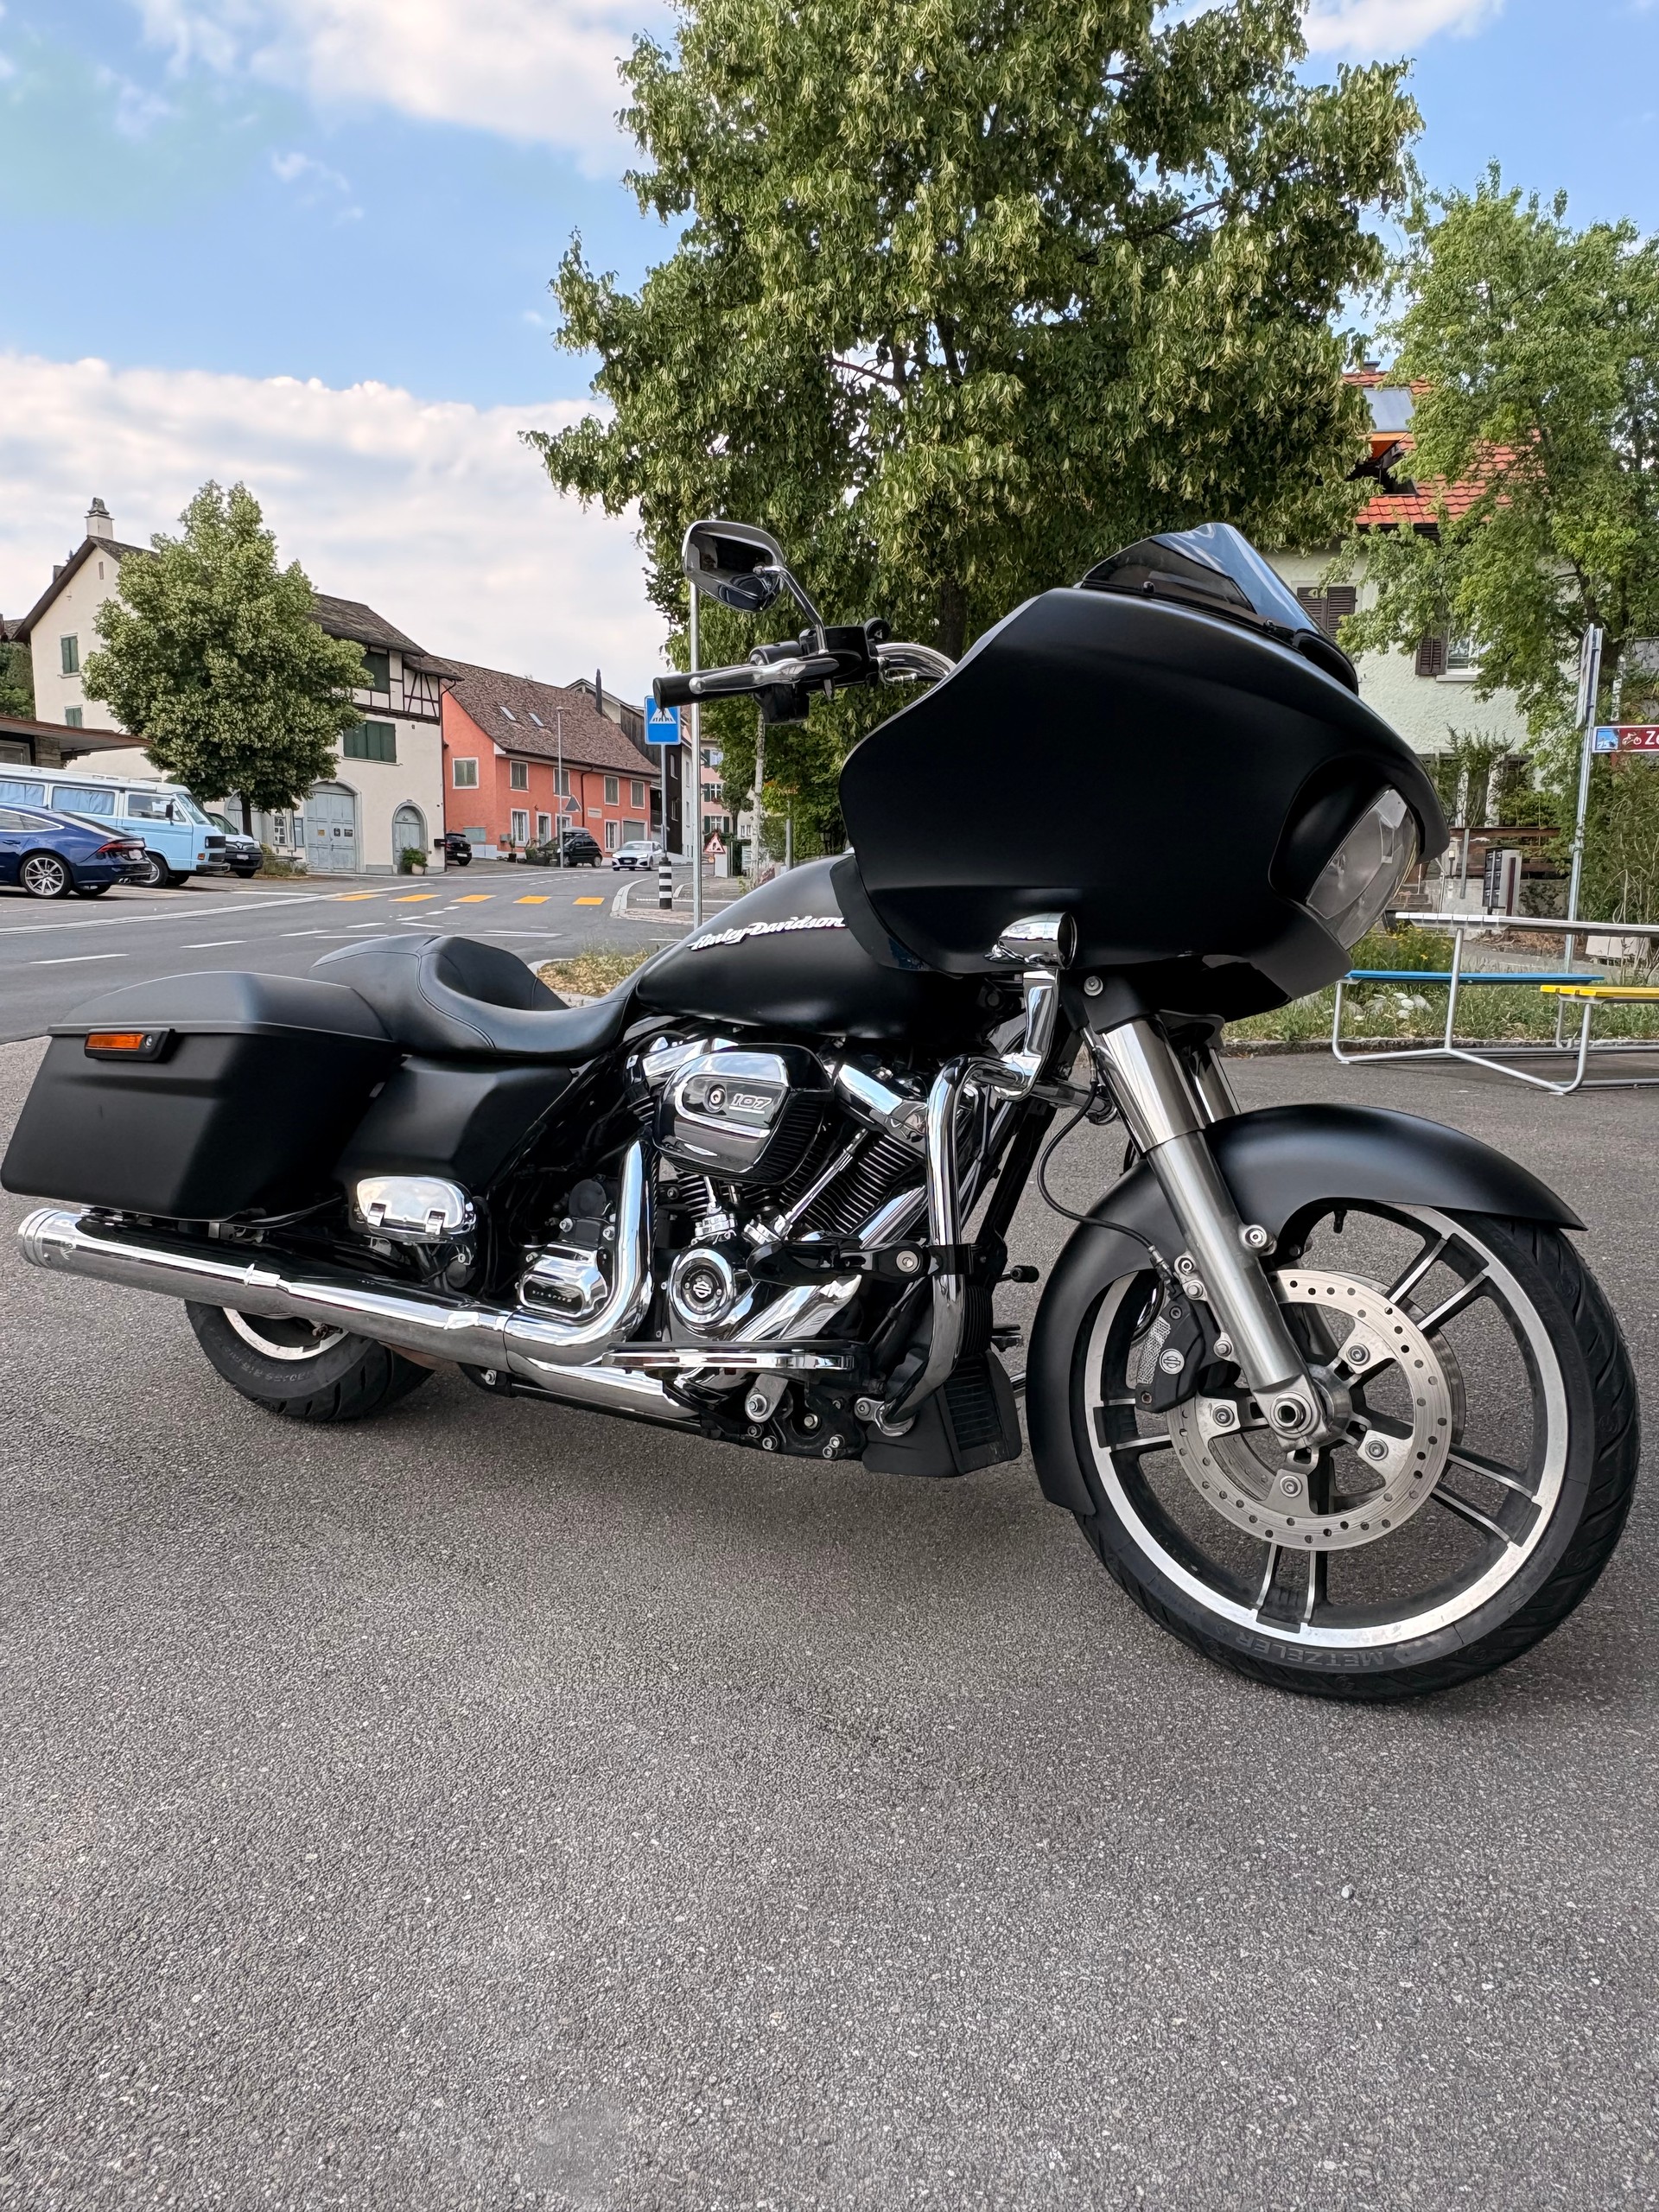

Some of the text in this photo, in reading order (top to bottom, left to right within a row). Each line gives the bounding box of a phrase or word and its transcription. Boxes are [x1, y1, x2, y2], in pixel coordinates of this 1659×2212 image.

[686, 915, 846, 951] Harley-Davidson
[730, 1092, 772, 1110] 107
[1236, 1631, 1383, 1668] METZELER
